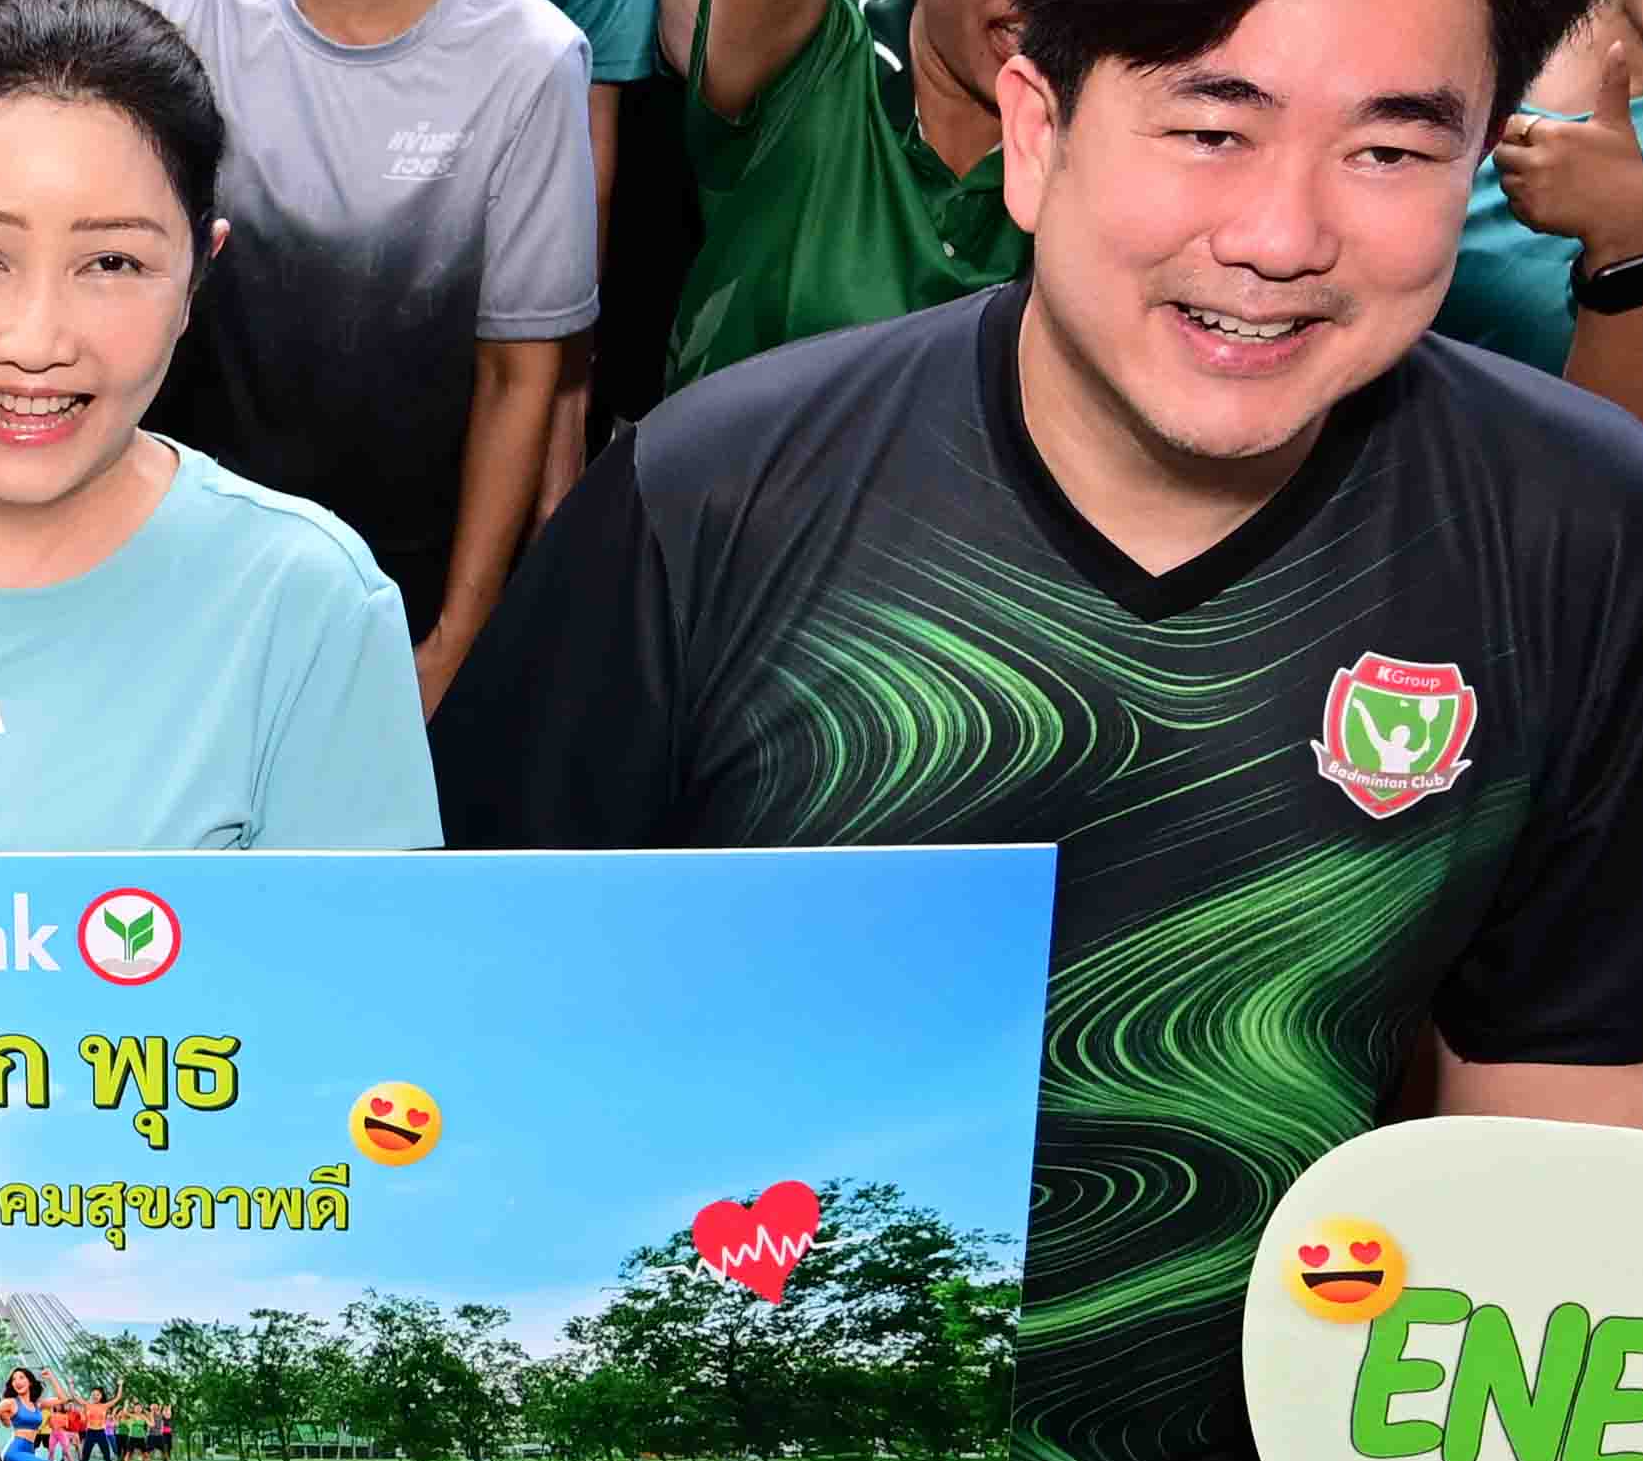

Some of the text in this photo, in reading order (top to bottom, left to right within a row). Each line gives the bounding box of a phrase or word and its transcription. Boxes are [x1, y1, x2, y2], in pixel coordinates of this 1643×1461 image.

[1376, 665, 1442, 691] KGroup
[1327, 759, 1446, 790] Badminton Club
[77, 1029, 244, 1150] พุธ
